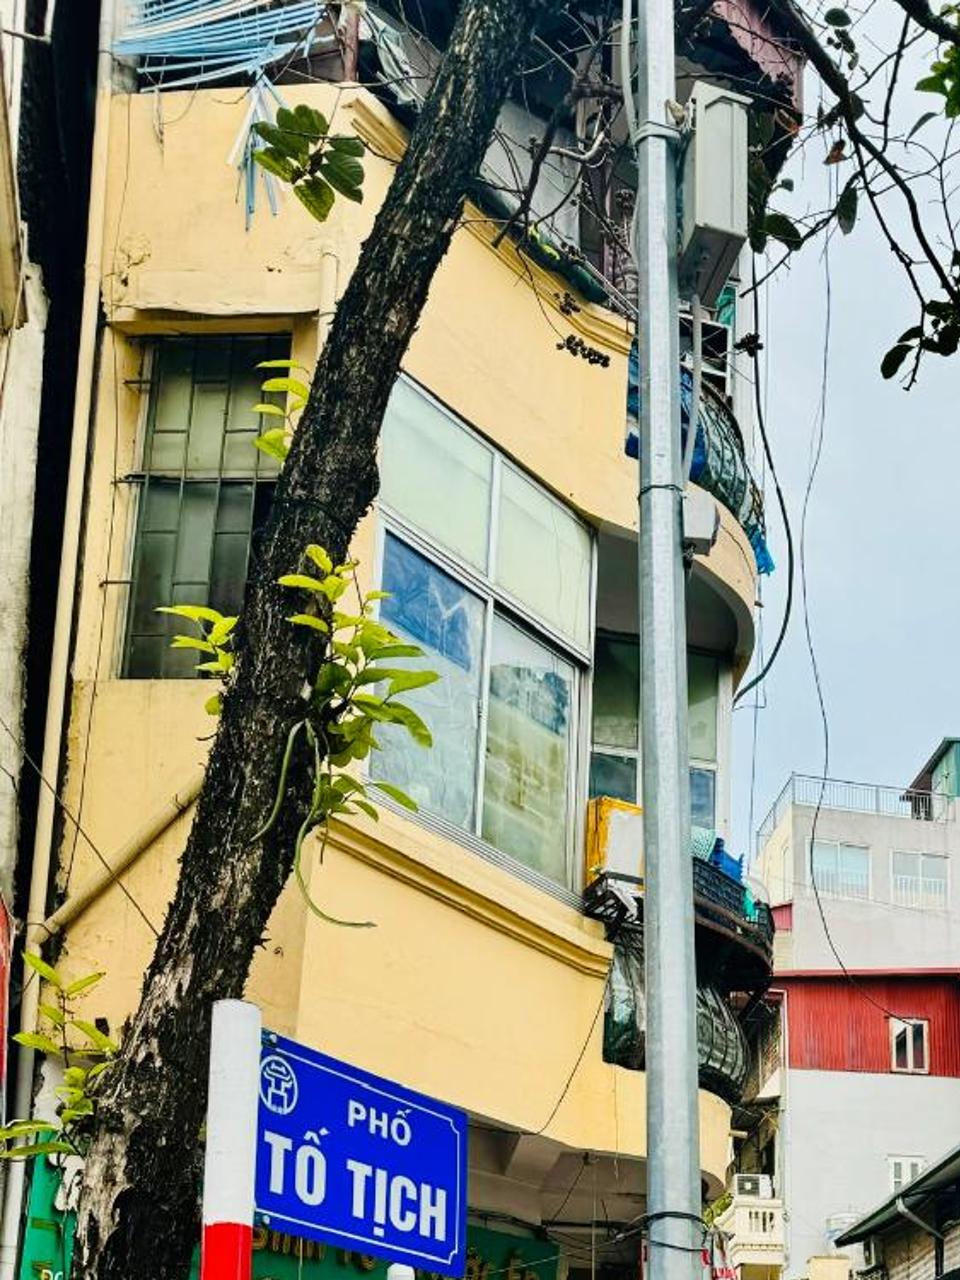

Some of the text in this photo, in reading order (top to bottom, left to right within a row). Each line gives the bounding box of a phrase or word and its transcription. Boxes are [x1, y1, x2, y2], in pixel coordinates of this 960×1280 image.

[347, 1098, 413, 1147] PHỐ
[264, 1126, 447, 1242] TỐ TỊCH
